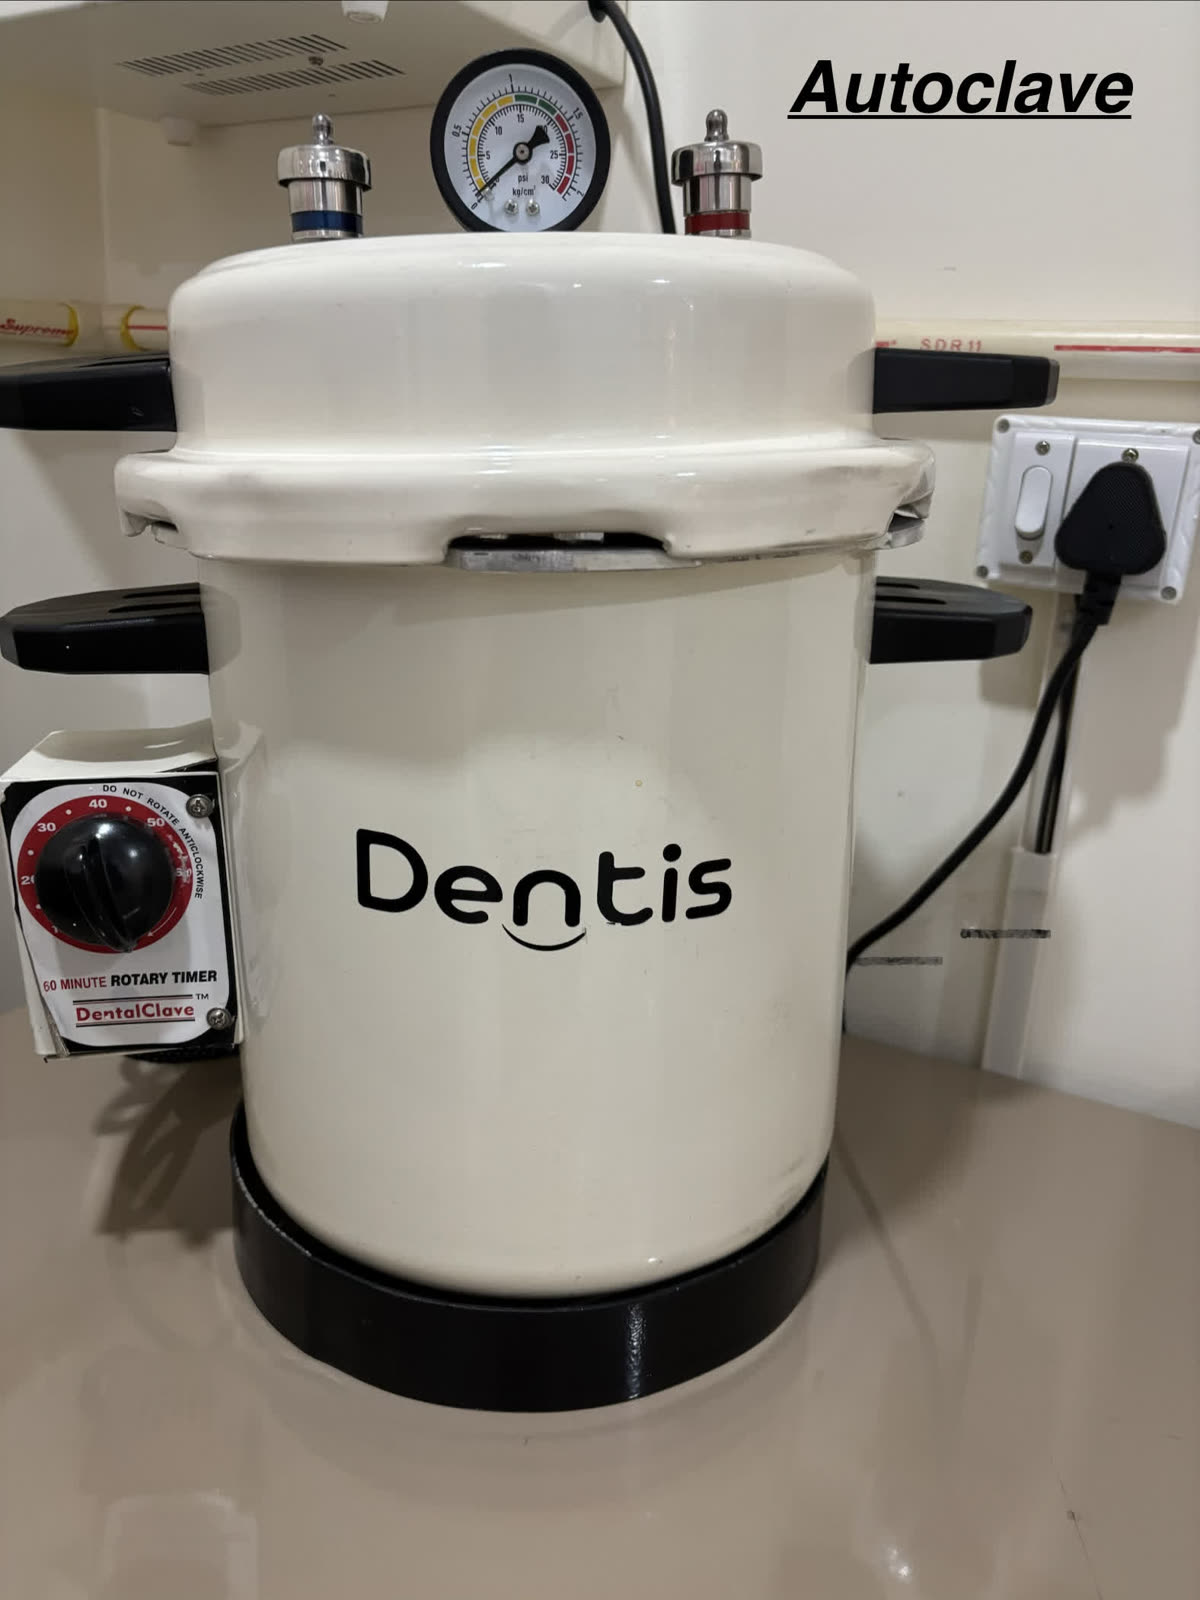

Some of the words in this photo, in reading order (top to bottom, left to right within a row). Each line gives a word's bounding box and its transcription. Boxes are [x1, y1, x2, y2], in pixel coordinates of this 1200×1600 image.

[517, 114, 525, 123] 15
[573, 107, 583, 120] 1.5
[452, 124, 462, 138] 0.5
[495, 127, 503, 136] 10
[486, 150, 491, 160] 5
[550, 150, 559, 160] 25
[518, 173, 528, 184] psi
[541, 175, 549, 184] 30
[471, 202, 478, 210] 0
[89, 799, 108, 808] 40
[37, 823, 56, 832] 30
[147, 818, 165, 827] 50
[102, 785, 117, 793] DO
[123, 787, 144, 799] NOT
[147, 798, 180, 826] ROTATE
[179, 827, 205, 899] ANTICLOCKWISE
[356, 828, 732, 926] Dentis
[43, 980, 57, 992] 60
[60, 976, 107, 990] MINUTE
[110, 973, 169, 987] ROTARY
[172, 970, 217, 984] TIMER
[75, 1003, 195, 1022] DentalClave
